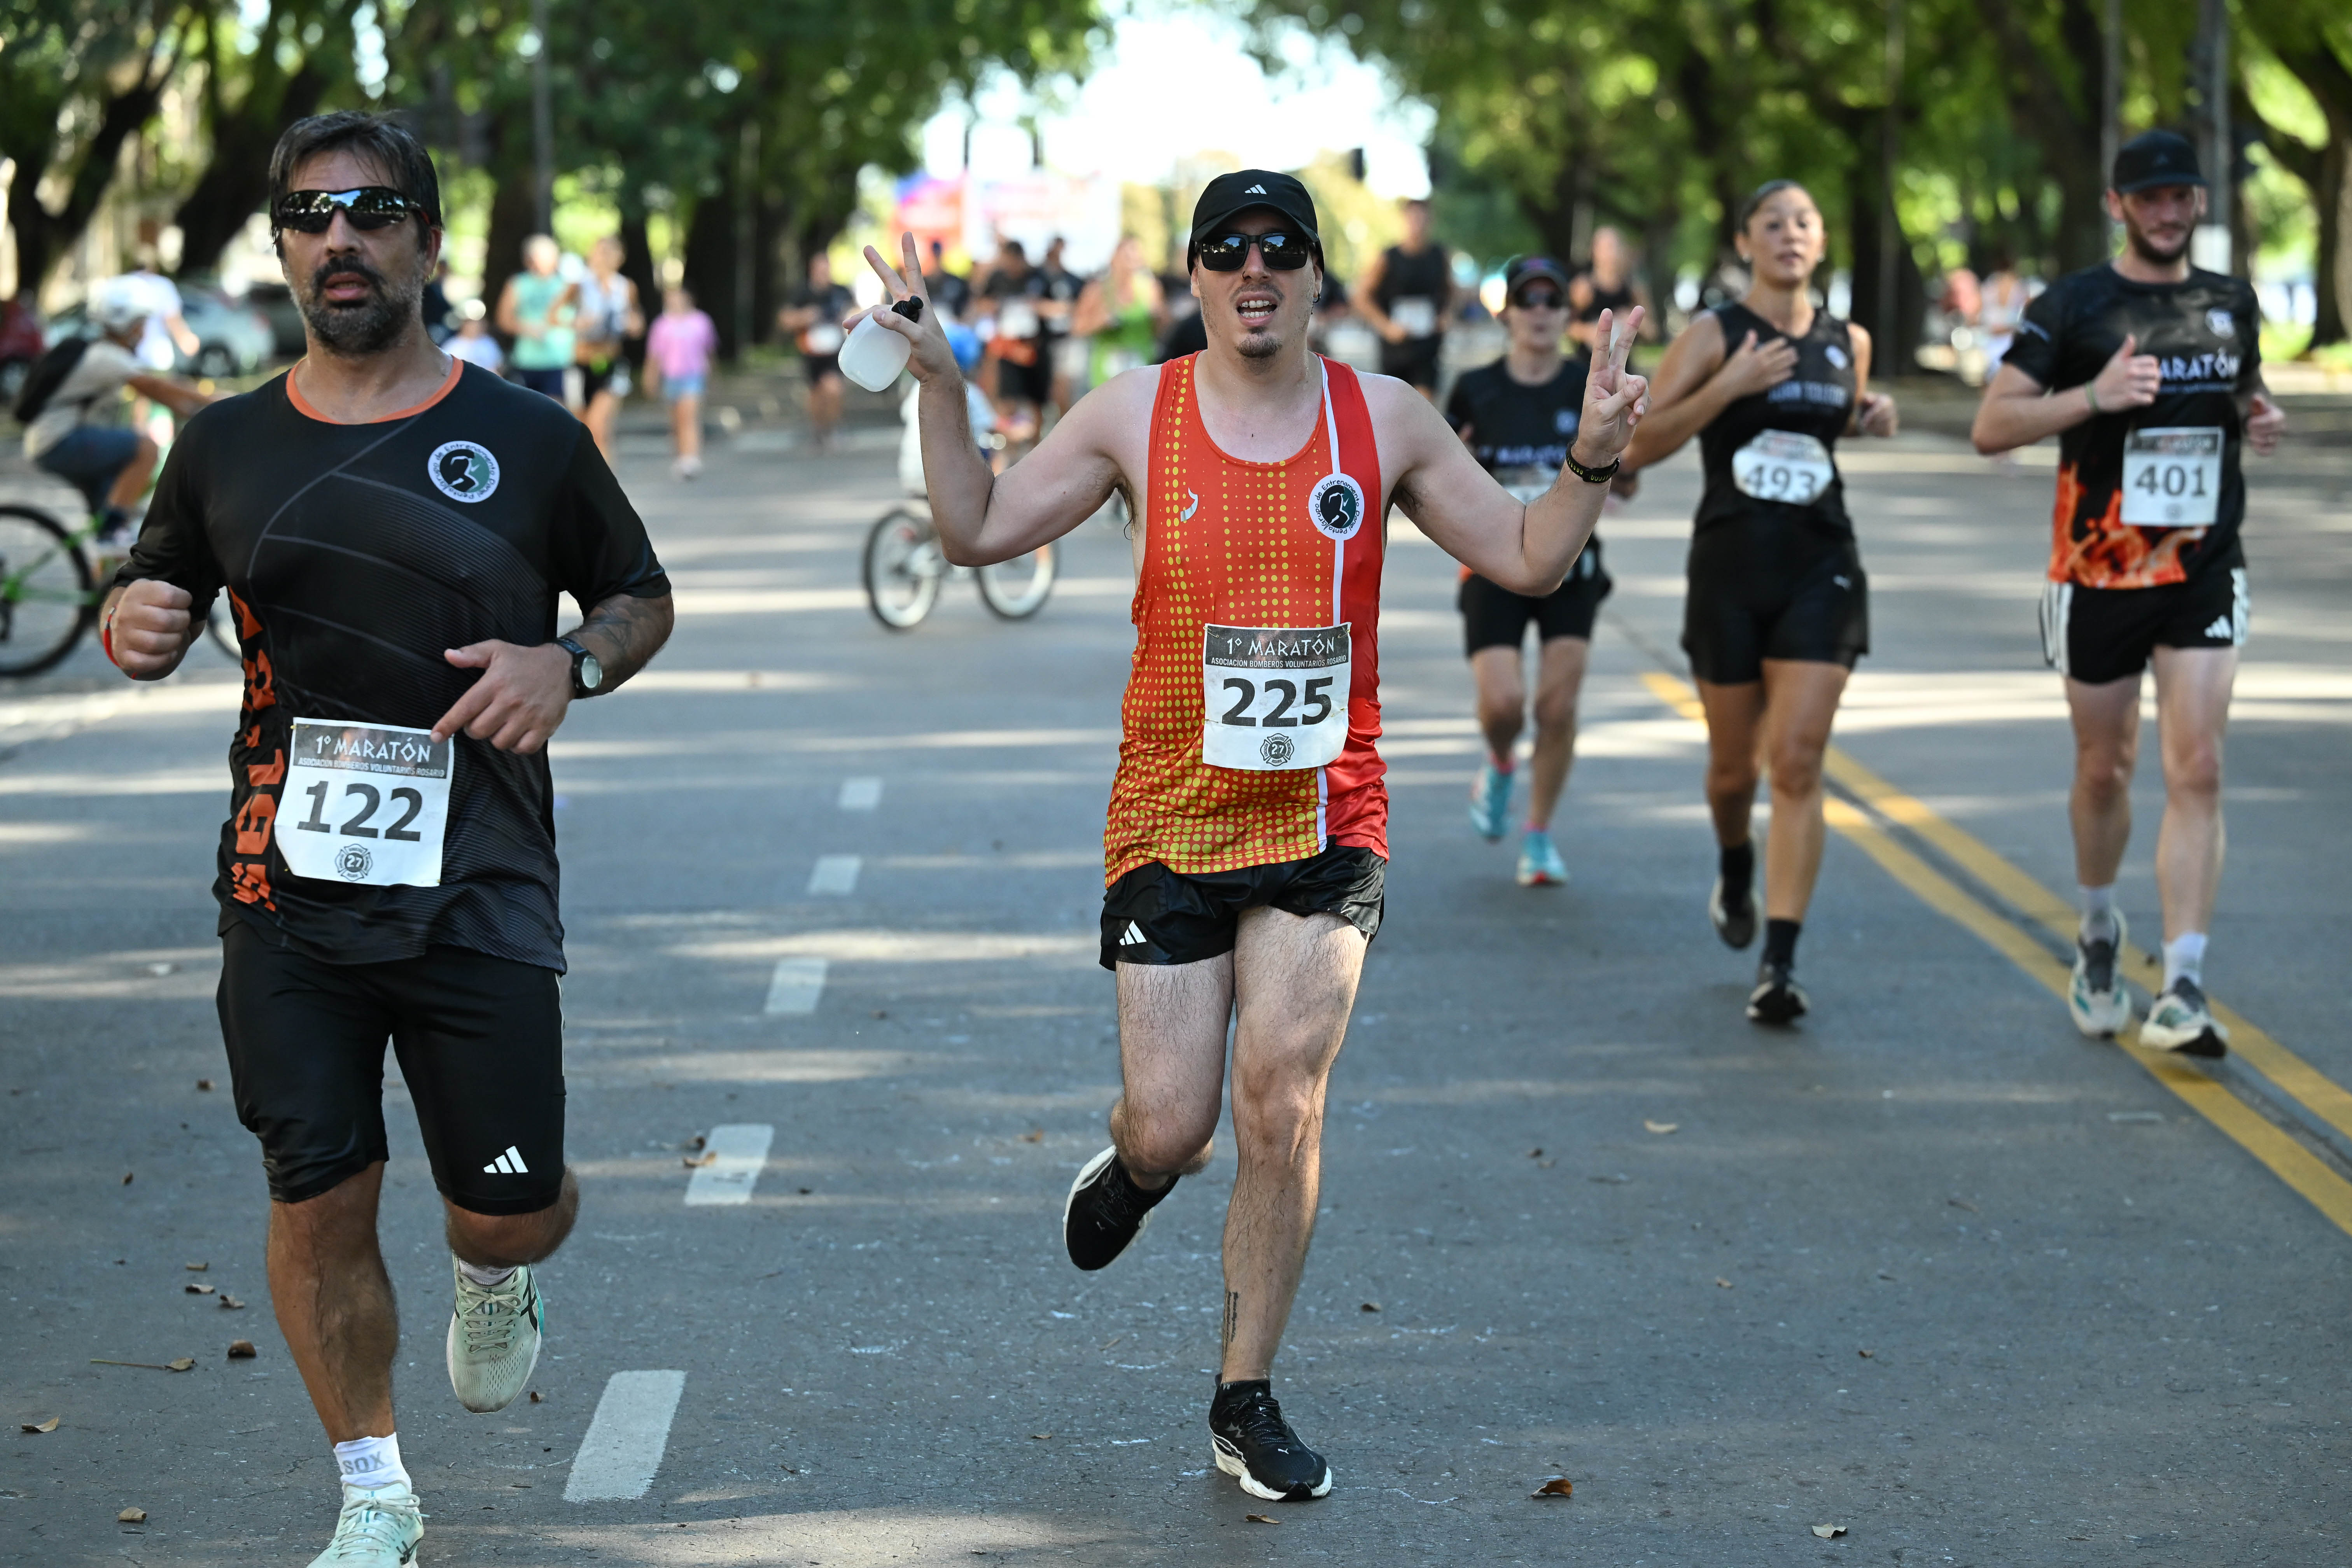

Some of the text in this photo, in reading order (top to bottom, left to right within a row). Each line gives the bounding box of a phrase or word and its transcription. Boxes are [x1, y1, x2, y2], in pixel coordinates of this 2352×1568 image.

[2160, 347, 2241, 381] ARATÓN
[1744, 466, 1817, 501] 493
[2135, 465, 2207, 497] 401
[1314, 480, 1360, 534] Grupo de Entrenamiento Daniel Penta
[1248, 634, 1335, 656] MARATÓN
[1211, 656, 1246, 667] ASOCIACIÓN
[1250, 660, 1283, 668] BOMBEROS
[1326, 655, 1346, 665] ROSARIO
[1222, 676, 1334, 727] 225
[333, 737, 431, 762] MARATÓN
[1271, 743, 1284, 755] 27
[416, 766, 444, 777] ROSARIO
[297, 780, 422, 842] 122
[346, 854, 363, 868] 27
[343, 1451, 385, 1475] SOX
